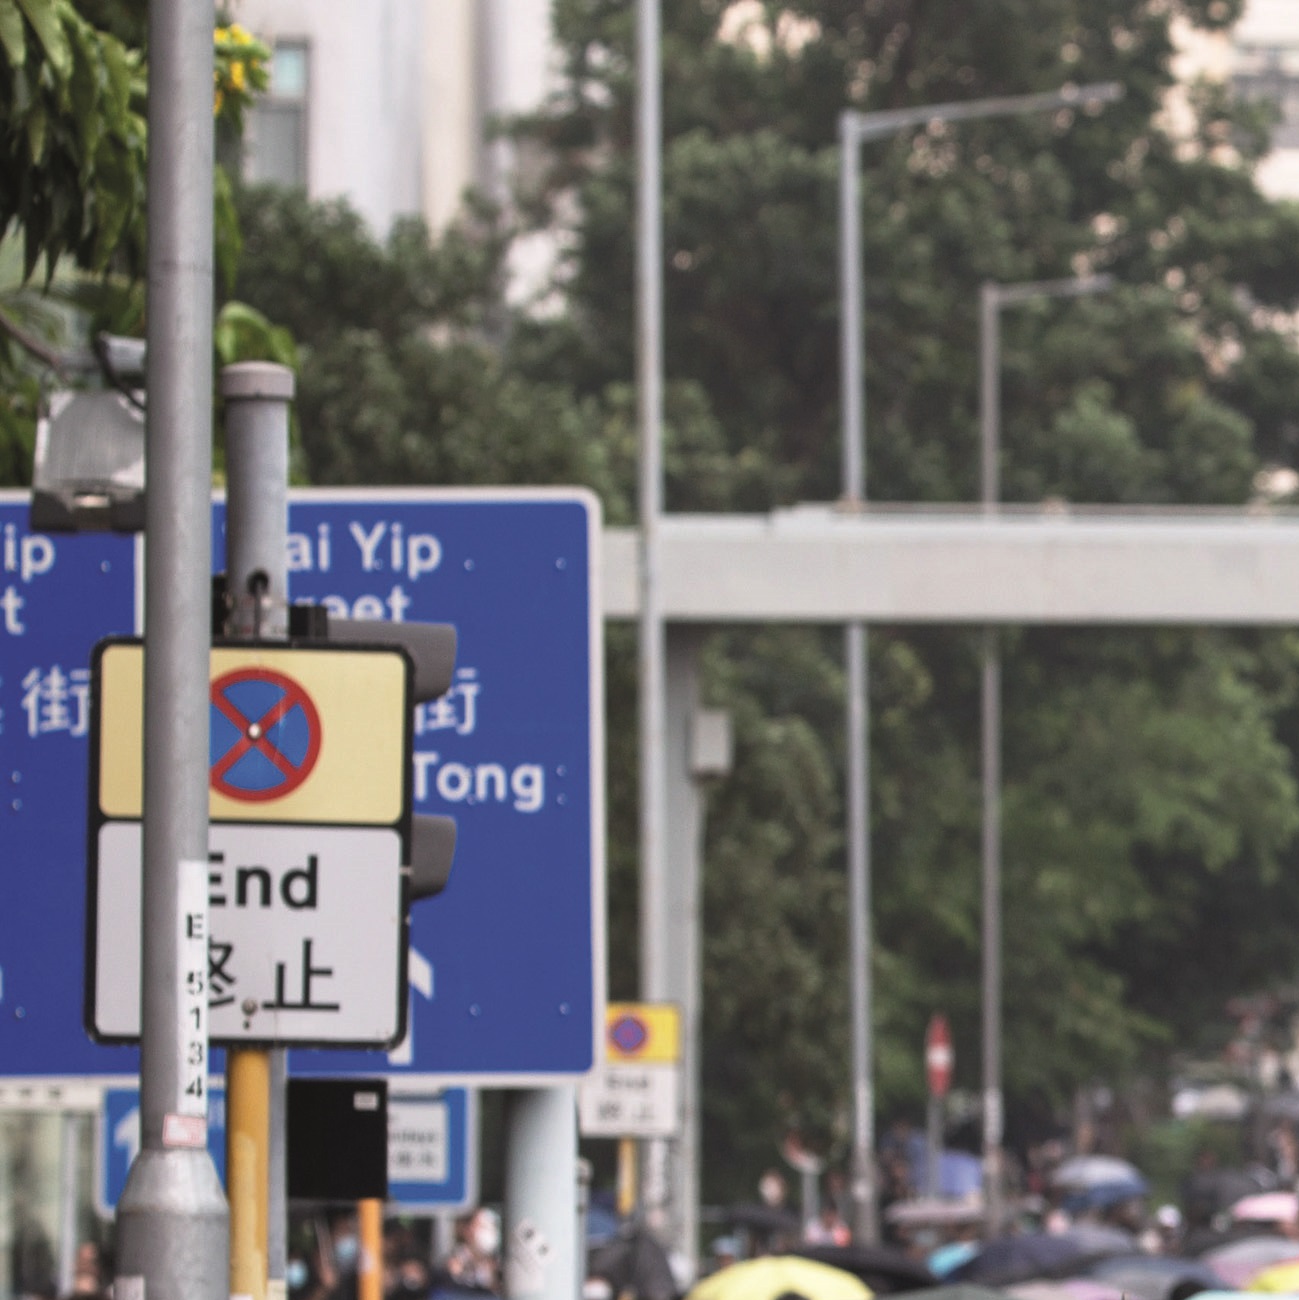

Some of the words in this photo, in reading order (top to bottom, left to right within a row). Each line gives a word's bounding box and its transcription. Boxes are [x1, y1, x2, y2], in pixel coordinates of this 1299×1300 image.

[349, 522, 443, 580] Yip
[412, 752, 545, 814] Tong
[208, 853, 319, 909] End
